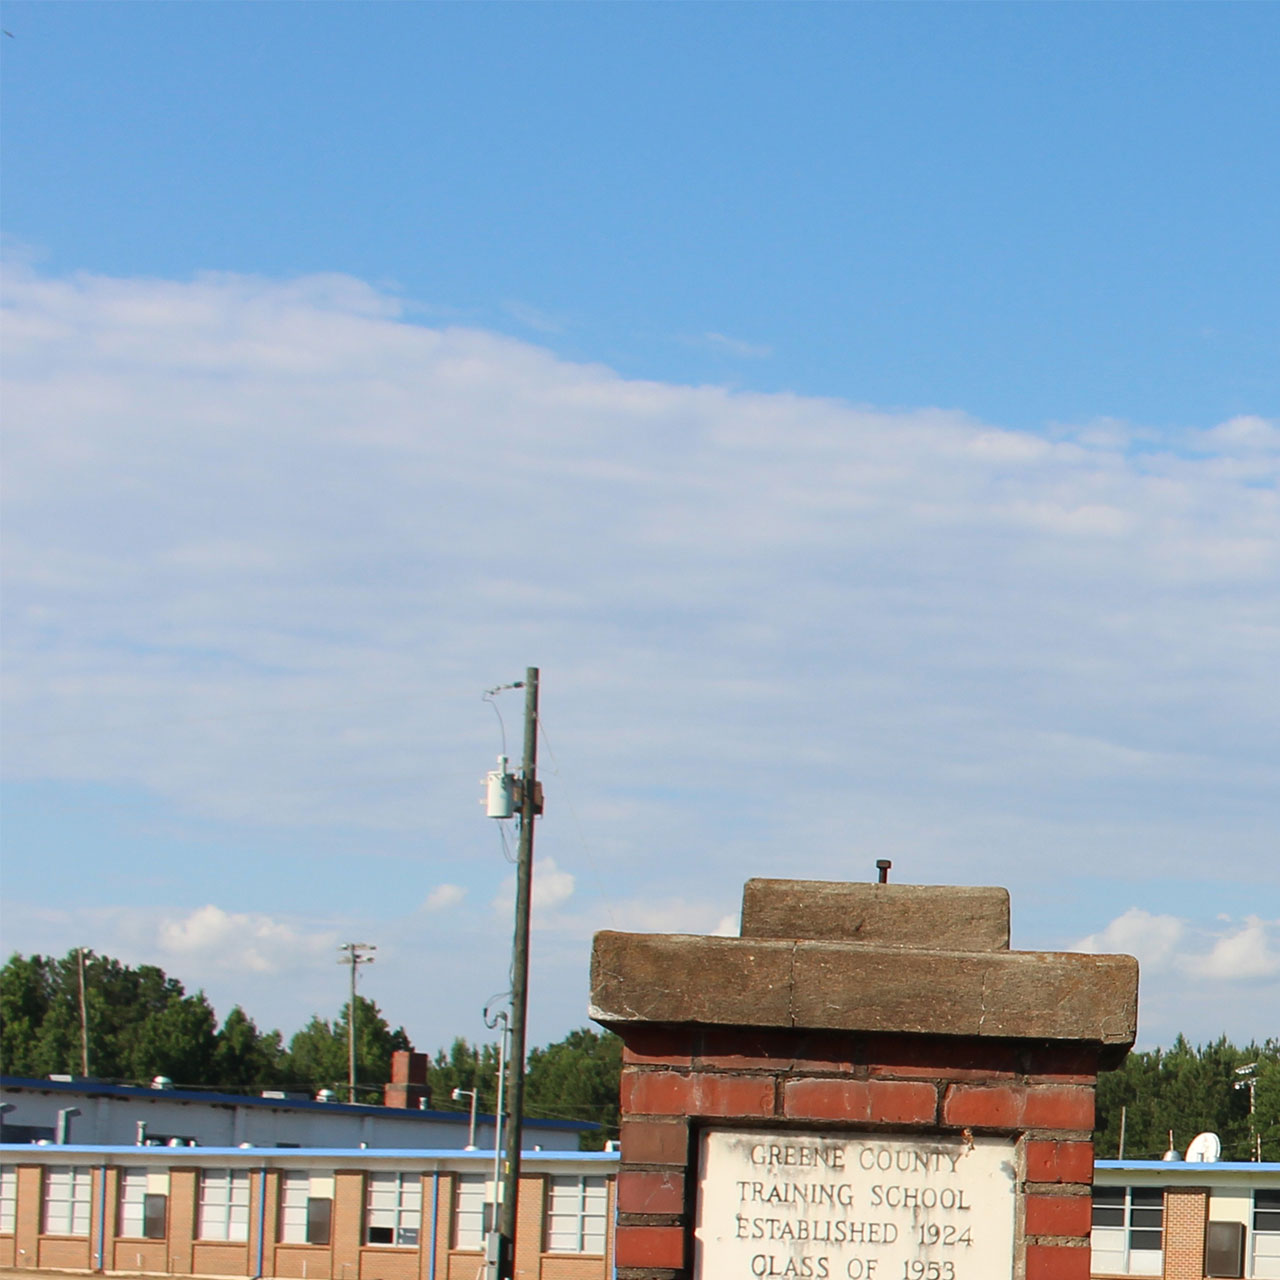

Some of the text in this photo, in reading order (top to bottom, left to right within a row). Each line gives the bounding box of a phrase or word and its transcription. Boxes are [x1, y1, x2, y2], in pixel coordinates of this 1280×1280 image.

[750, 1144, 963, 1173] GREENE COUNTY
[736, 1181, 971, 1210] TRAINING SCHOOL
[735, 1216, 974, 1247] ESTABLISHED 1924
[751, 1254, 830, 1279] CLASS
[847, 1257, 878, 1280] OF
